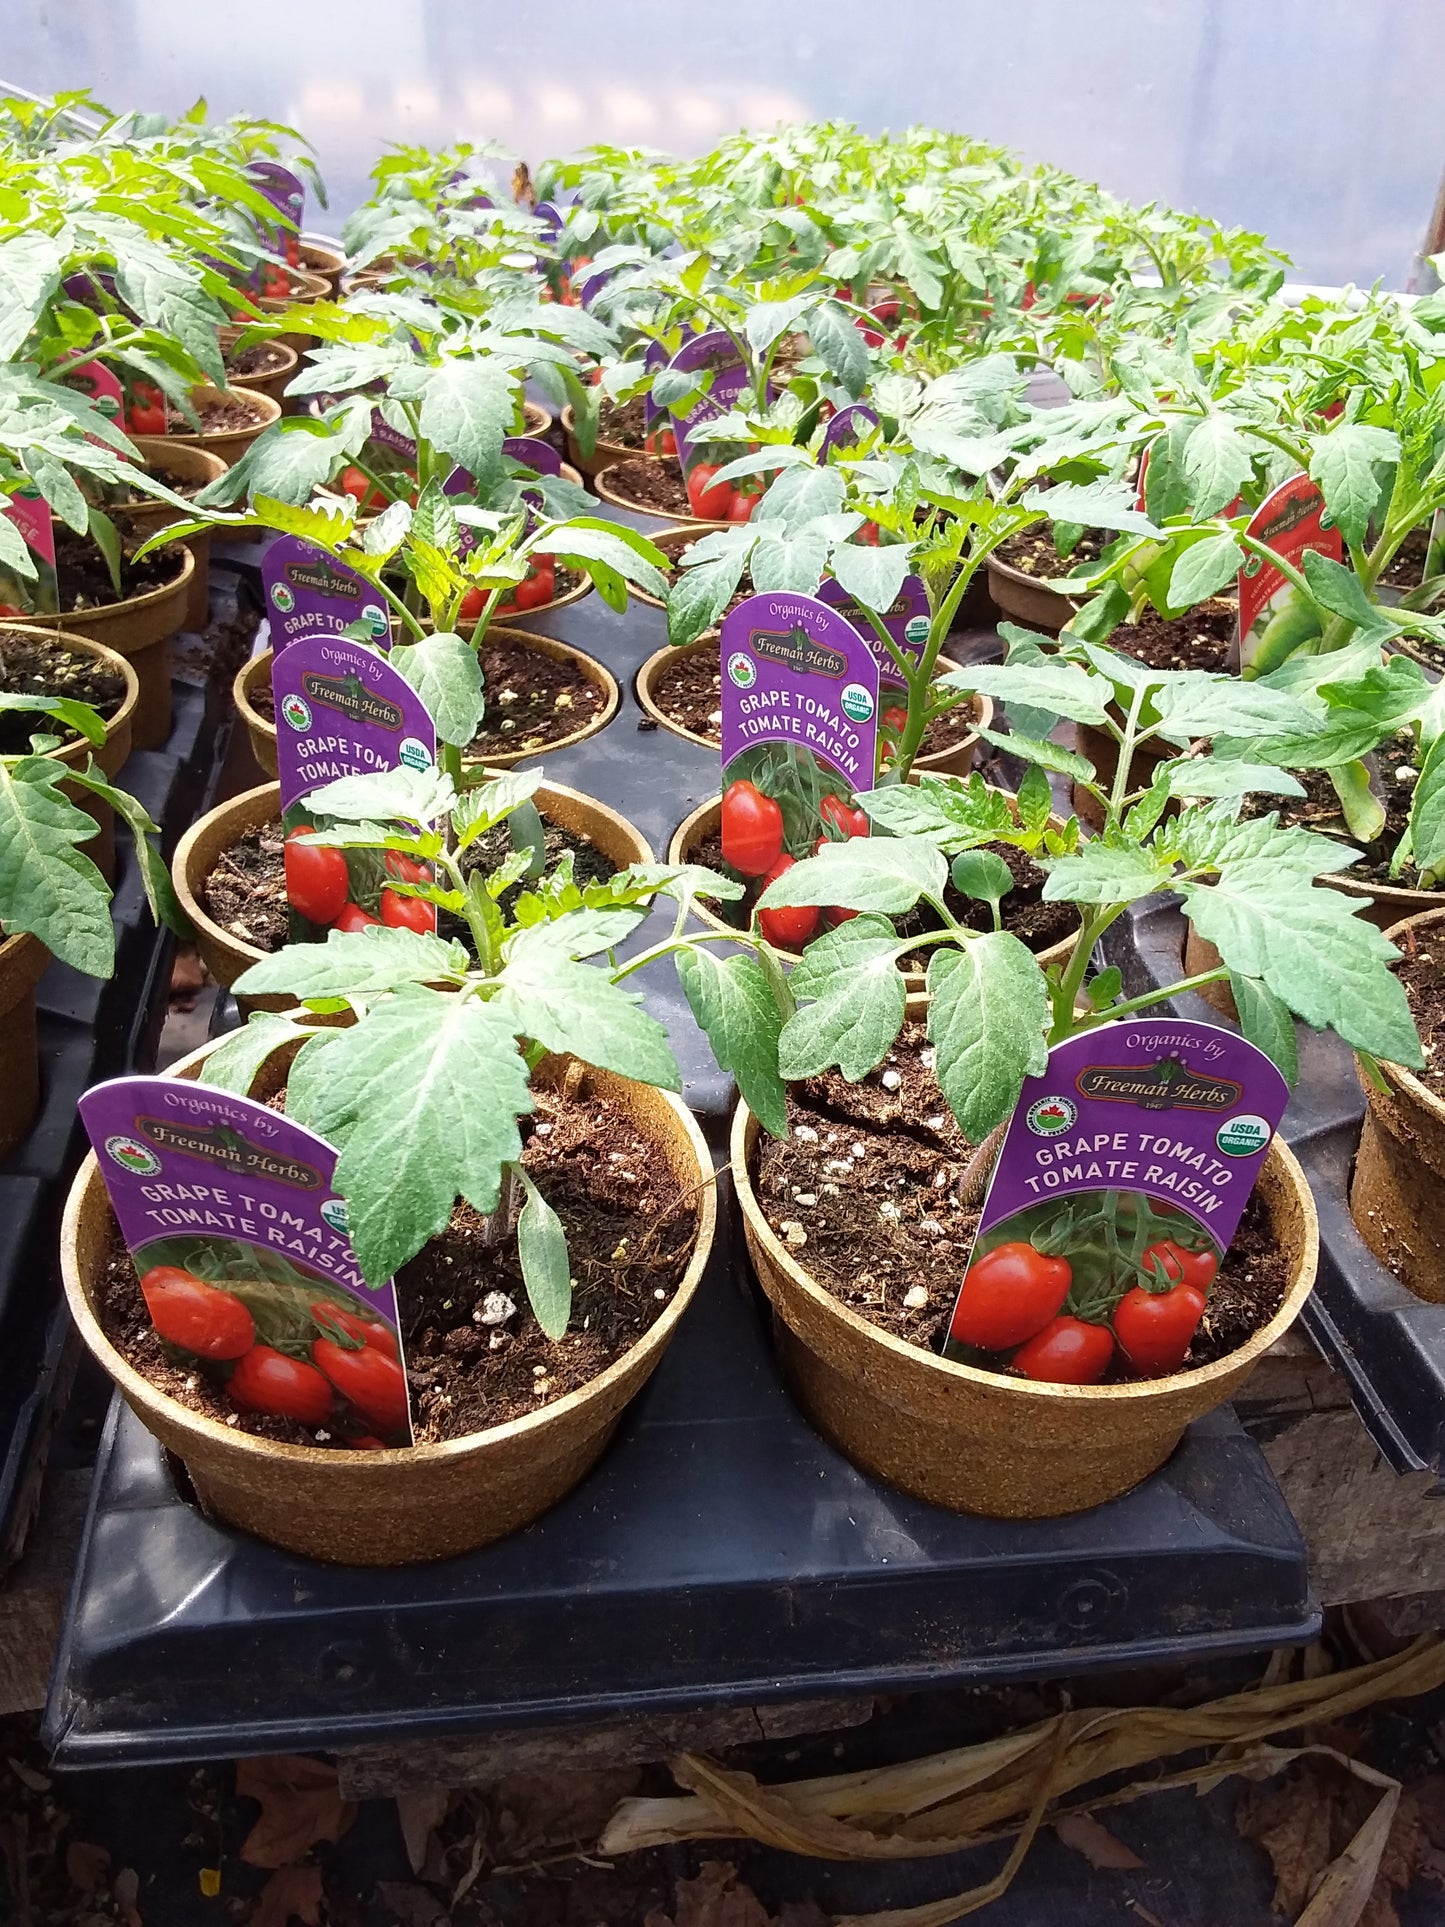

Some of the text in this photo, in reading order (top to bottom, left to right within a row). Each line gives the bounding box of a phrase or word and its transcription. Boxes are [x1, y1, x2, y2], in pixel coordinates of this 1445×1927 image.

[291, 569, 358, 595] Freeman Herbs
[284, 612, 324, 634] GRAPE
[769, 602, 830, 632] Organics by
[321, 646, 384, 682] Organics by
[756, 637, 804, 661] Freeman
[805, 651, 840, 671] Herbs
[311, 681, 396, 723] Freeman Herbs
[844, 702, 870, 715] ORGANIC
[848, 691, 867, 704] USDA
[739, 690, 861, 749] GRAPE TOMATO
[296, 736, 390, 773] GRAPE TOM
[405, 744, 426, 759] USDA
[738, 715, 859, 774] TOMATE RAISIN
[296, 761, 361, 783] TOMATE
[1126, 1034, 1226, 1061] Organics by
[1088, 1075, 1229, 1103] Freeman Herbs
[163, 1092, 280, 1137] Organics by
[1145, 1102, 1163, 1110] 1947
[1221, 1136, 1261, 1147] ORGANIC
[1230, 1123, 1261, 1135] USDA
[153, 1126, 242, 1163] Freeman
[247, 1152, 310, 1183] Herbs
[1035, 1132, 1234, 1187] GRAPE TOMATO
[1024, 1160, 1225, 1215] TOMATE RAISIN
[140, 1183, 359, 1263] GRAPE TOMATO
[145, 1208, 366, 1287] TOMATE RAISIN
